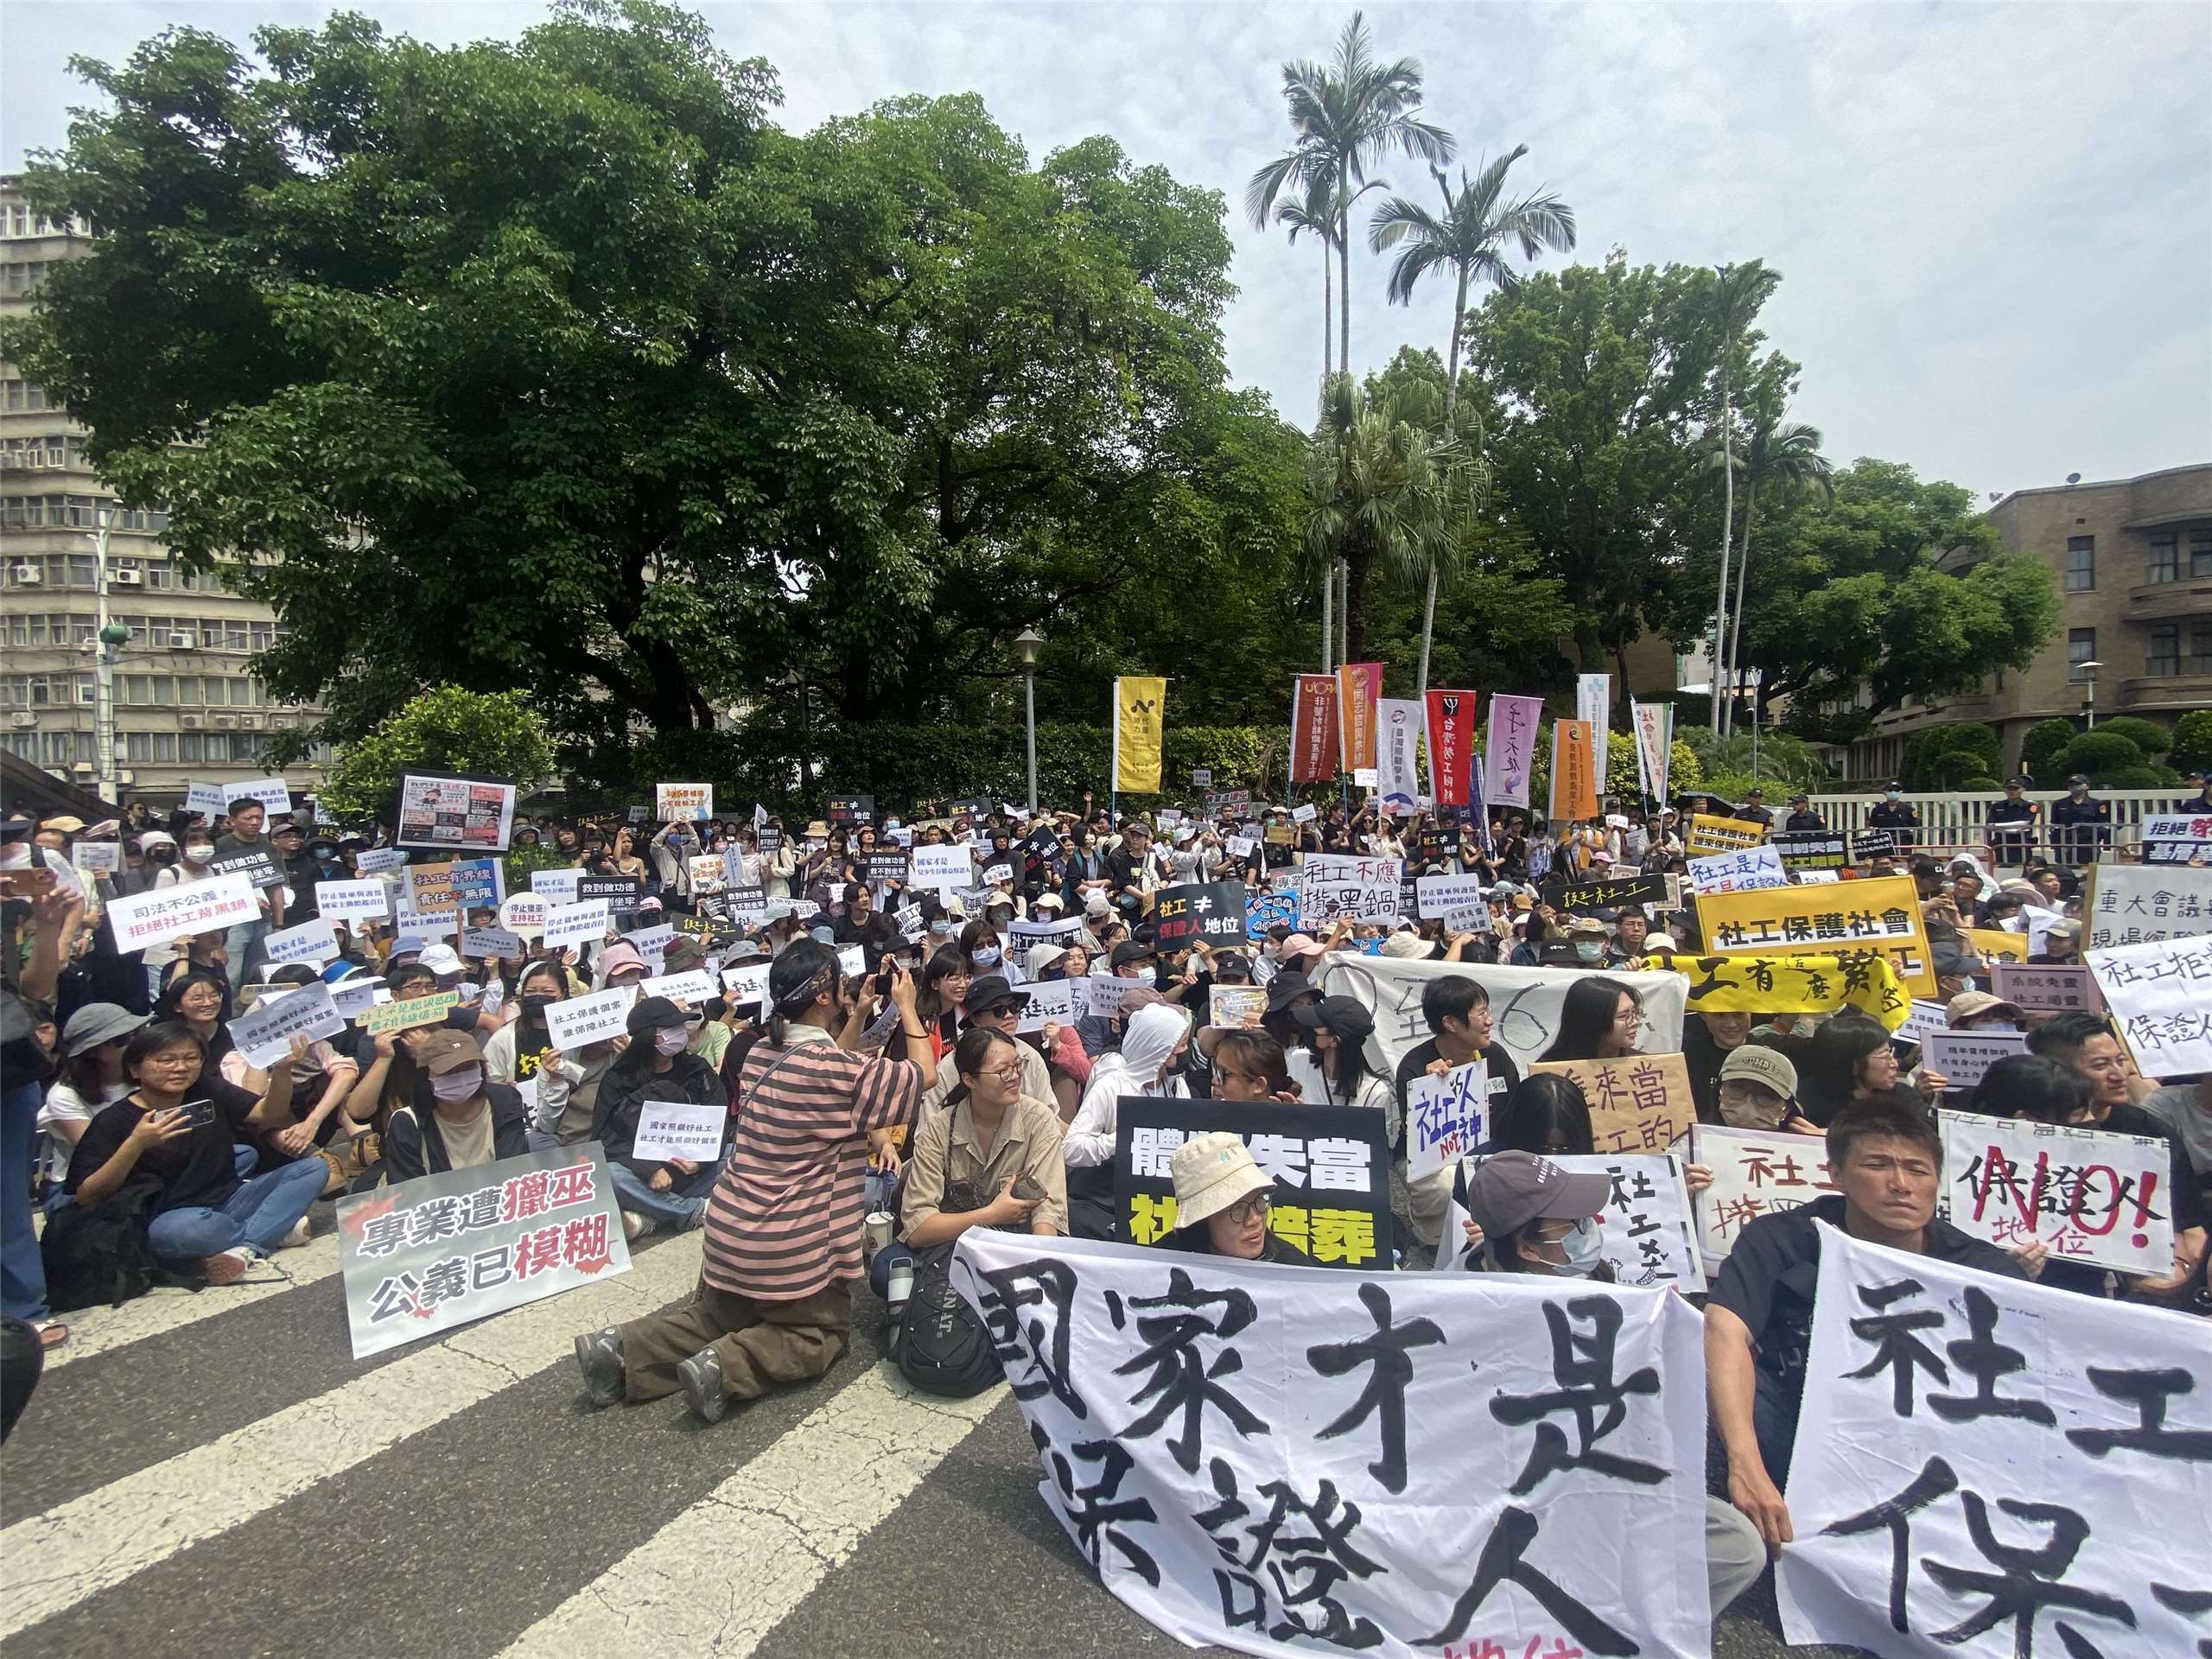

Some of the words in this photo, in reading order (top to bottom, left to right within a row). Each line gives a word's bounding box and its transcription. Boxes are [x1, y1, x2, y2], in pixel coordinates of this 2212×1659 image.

[1696, 824, 1758, 842] 社工保護社會
[917, 857, 948, 866] 國家才是
[1305, 860, 1399, 885] 社工不應
[1691, 853, 1777, 884] 社工是人
[415, 869, 492, 887] 社工有界線
[582, 882, 636, 893] 救到做功德
[418, 887, 493, 906] 責任不無限
[728, 890, 763, 900] 救到做功德
[1562, 882, 1652, 907] 挺社工
[128, 899, 248, 938] 拒絕社工背黑鍋
[1160, 898, 1187, 918] 社工
[683, 918, 736, 934] 挺社工
[1160, 917, 1240, 939] 保證人地位
[1718, 906, 1911, 947] 社工保護社會
[2012, 976, 2078, 988] 系統失靈
[553, 1000, 621, 1026] 社工保護個案
[562, 1016, 620, 1039] 誰保障社工
[649, 1121, 712, 1133] 國家照顧好社工
[1414, 1090, 1457, 1153] 社工
[1458, 1109, 1481, 1152] 神
[640, 1134, 718, 1145] 社工才能照顧好個案
[1130, 1126, 1372, 1192] 體失當
[1956, 1154, 2167, 1221] 保證人
[356, 1162, 596, 1259] 專業遭獵巫
[1990, 1215, 2094, 1255] 地位
[366, 1211, 610, 1326] 公義已模糊
[956, 1255, 1673, 1497] 國家才是
[1838, 1279, 2212, 1461] 社工
